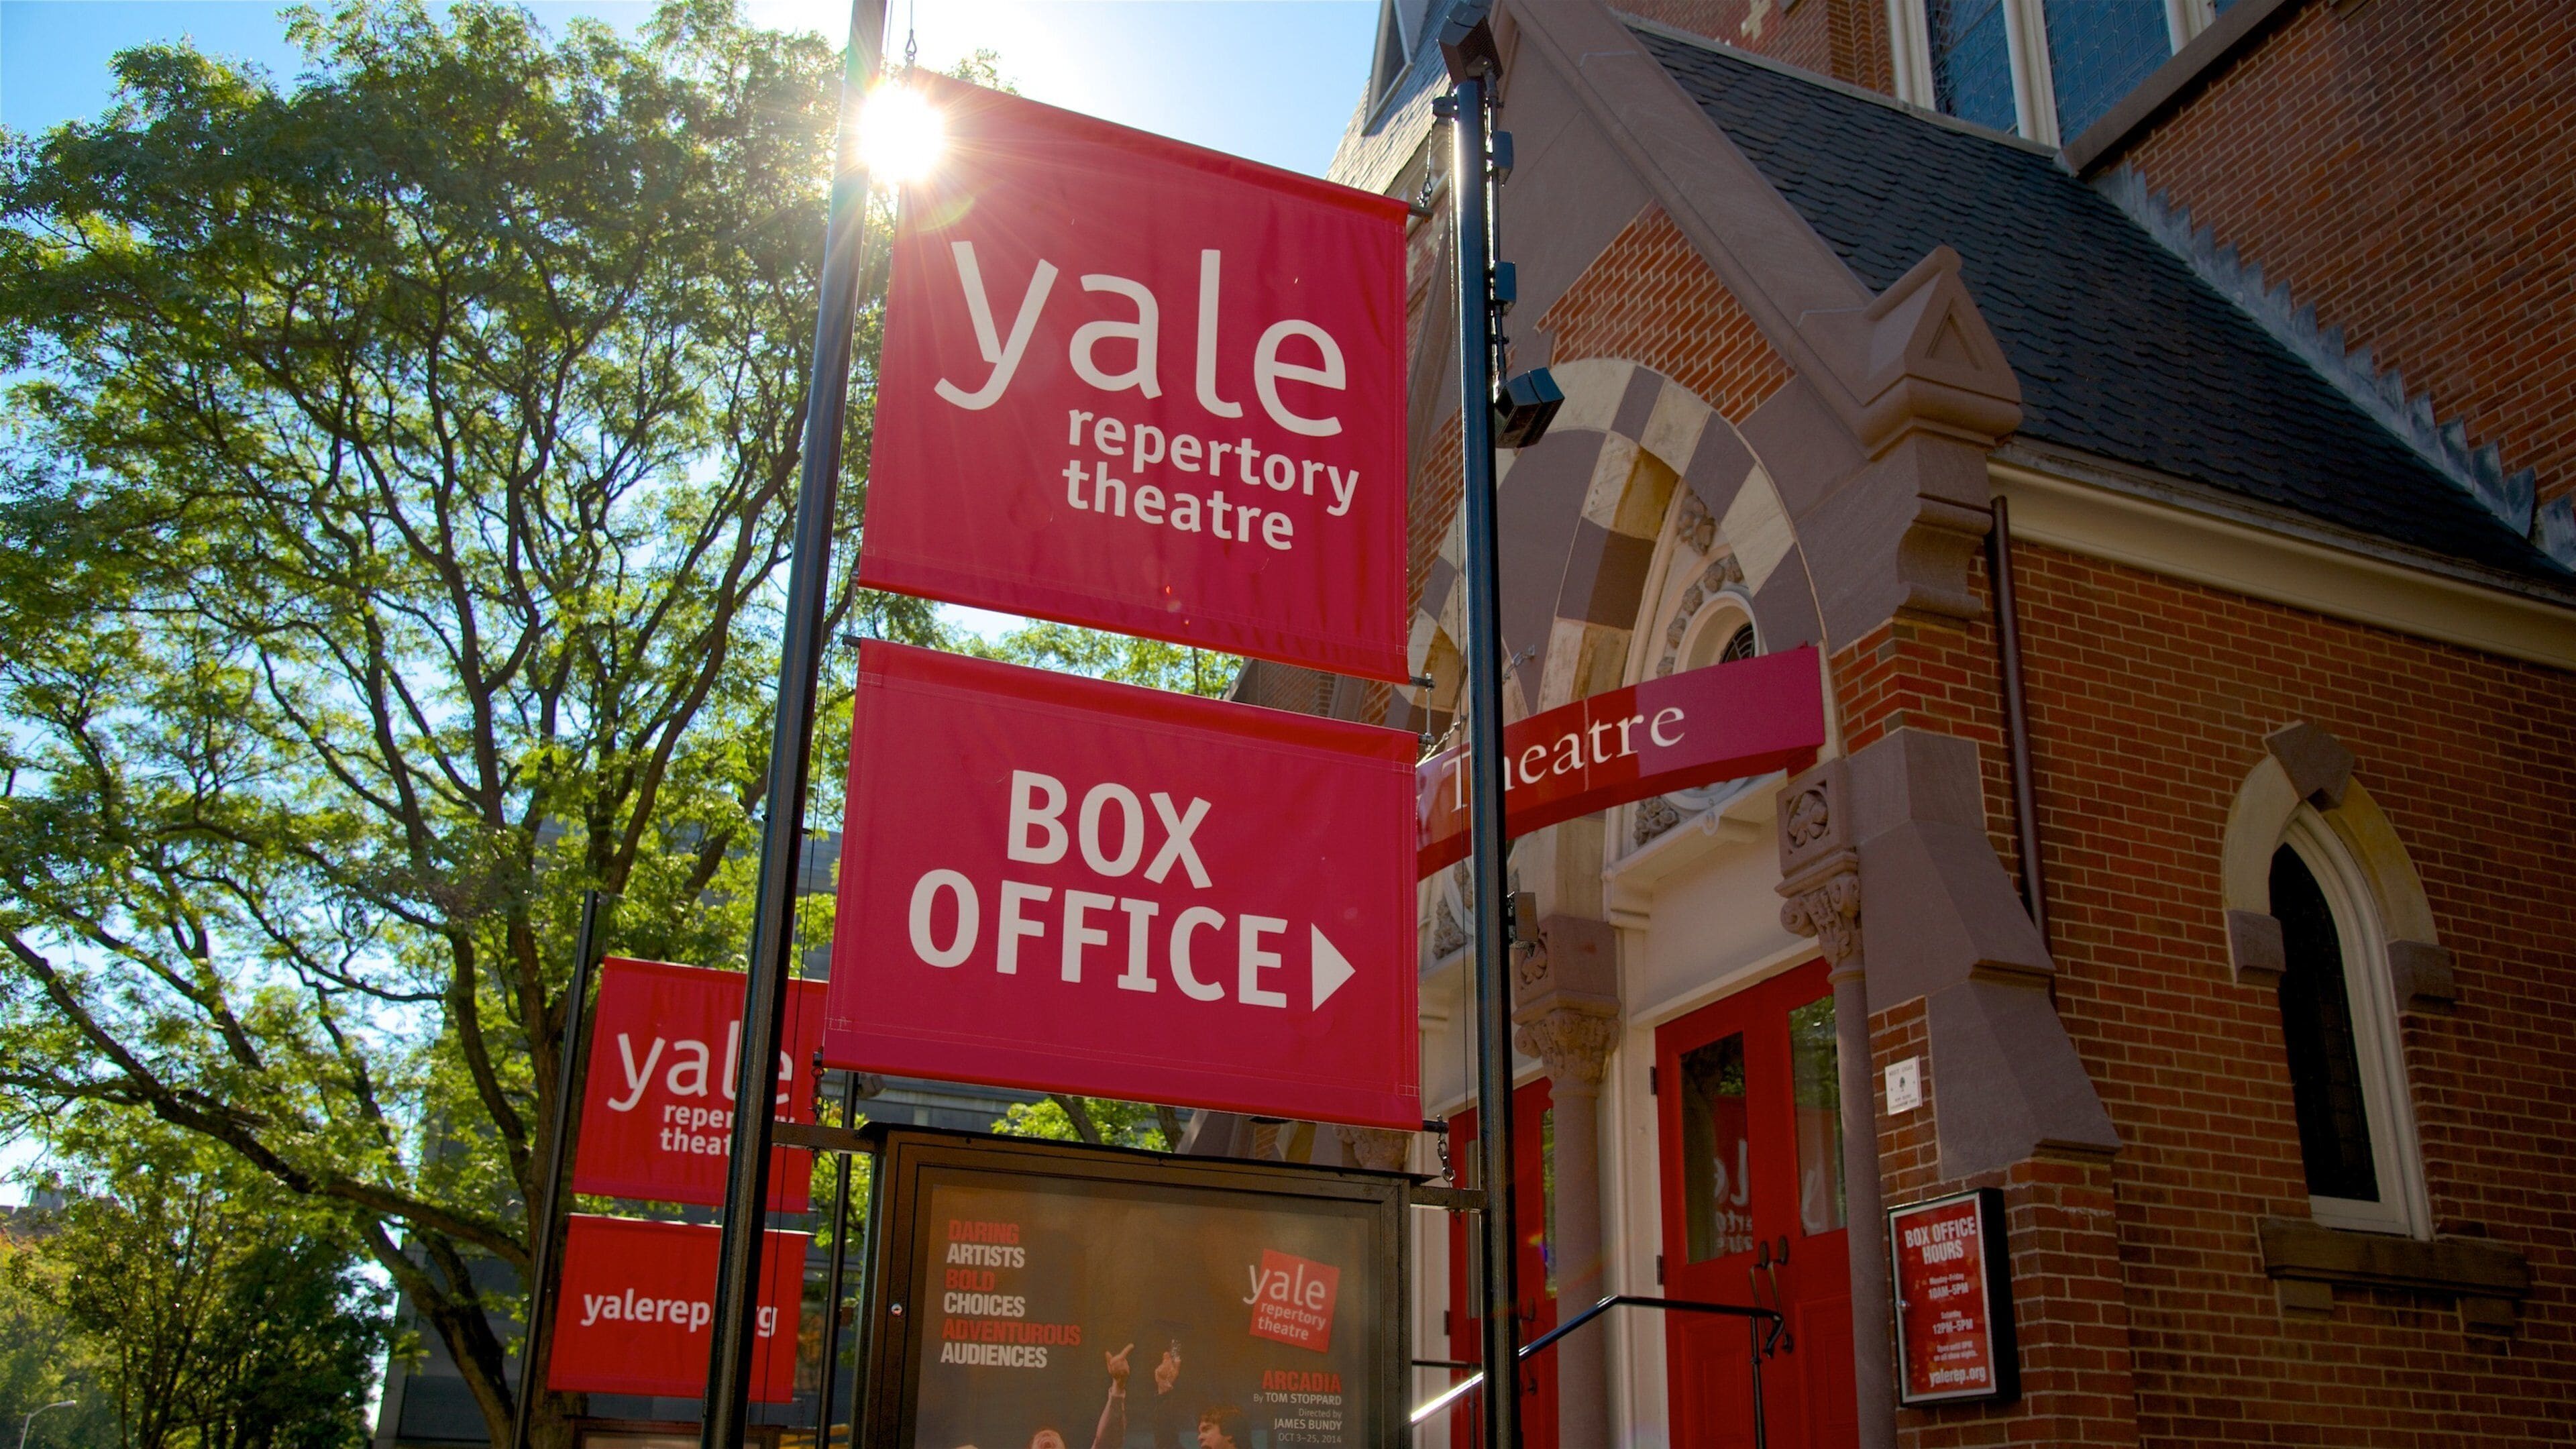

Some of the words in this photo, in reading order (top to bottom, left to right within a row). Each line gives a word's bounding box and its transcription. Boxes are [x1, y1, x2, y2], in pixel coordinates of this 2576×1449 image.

[934, 241, 1346, 437] yale
[1068, 409, 1360, 517] repertory
[1062, 459, 1293, 550] theatre
[1007, 769, 1212, 889] BOX
[908, 869, 1289, 1008] OFFICE
[660, 1126, 732, 1157] theat
[948, 1220, 1020, 1244] DARING
[1904, 1226, 1929, 1248] BOX
[1932, 1216, 1976, 1243] OFFICE
[947, 1243, 1026, 1269] ARTISTS
[1922, 1240, 1964, 1265] HOURS
[945, 1269, 996, 1292] BOLD
[1242, 1264, 1326, 1310] yale
[580, 1287, 778, 1338] yalerepg
[944, 1292, 1026, 1318] CHOICES
[1261, 1301, 1326, 1332] repertory
[941, 1318, 1082, 1346] ADVENTUROUS
[1258, 1316, 1309, 1340] theatre
[941, 1342, 1048, 1368] AUDIENCES
[1261, 1369, 1342, 1393] ARCADIA
[1929, 1366, 1986, 1388] yalerep.org
[1253, 1393, 1264, 1404] By
[1265, 1392, 1288, 1403] TOM
[1290, 1393, 1342, 1405] STOPPARD
[1274, 1418, 1306, 1430] JAMES
[1308, 1419, 1342, 1430] BUNDY
[1299, 1408, 1331, 1417] Directed
[1332, 1409, 1342, 1419] by
[1278, 1432, 1294, 1442] OCT
[1322, 1434, 1342, 1443] 2014
